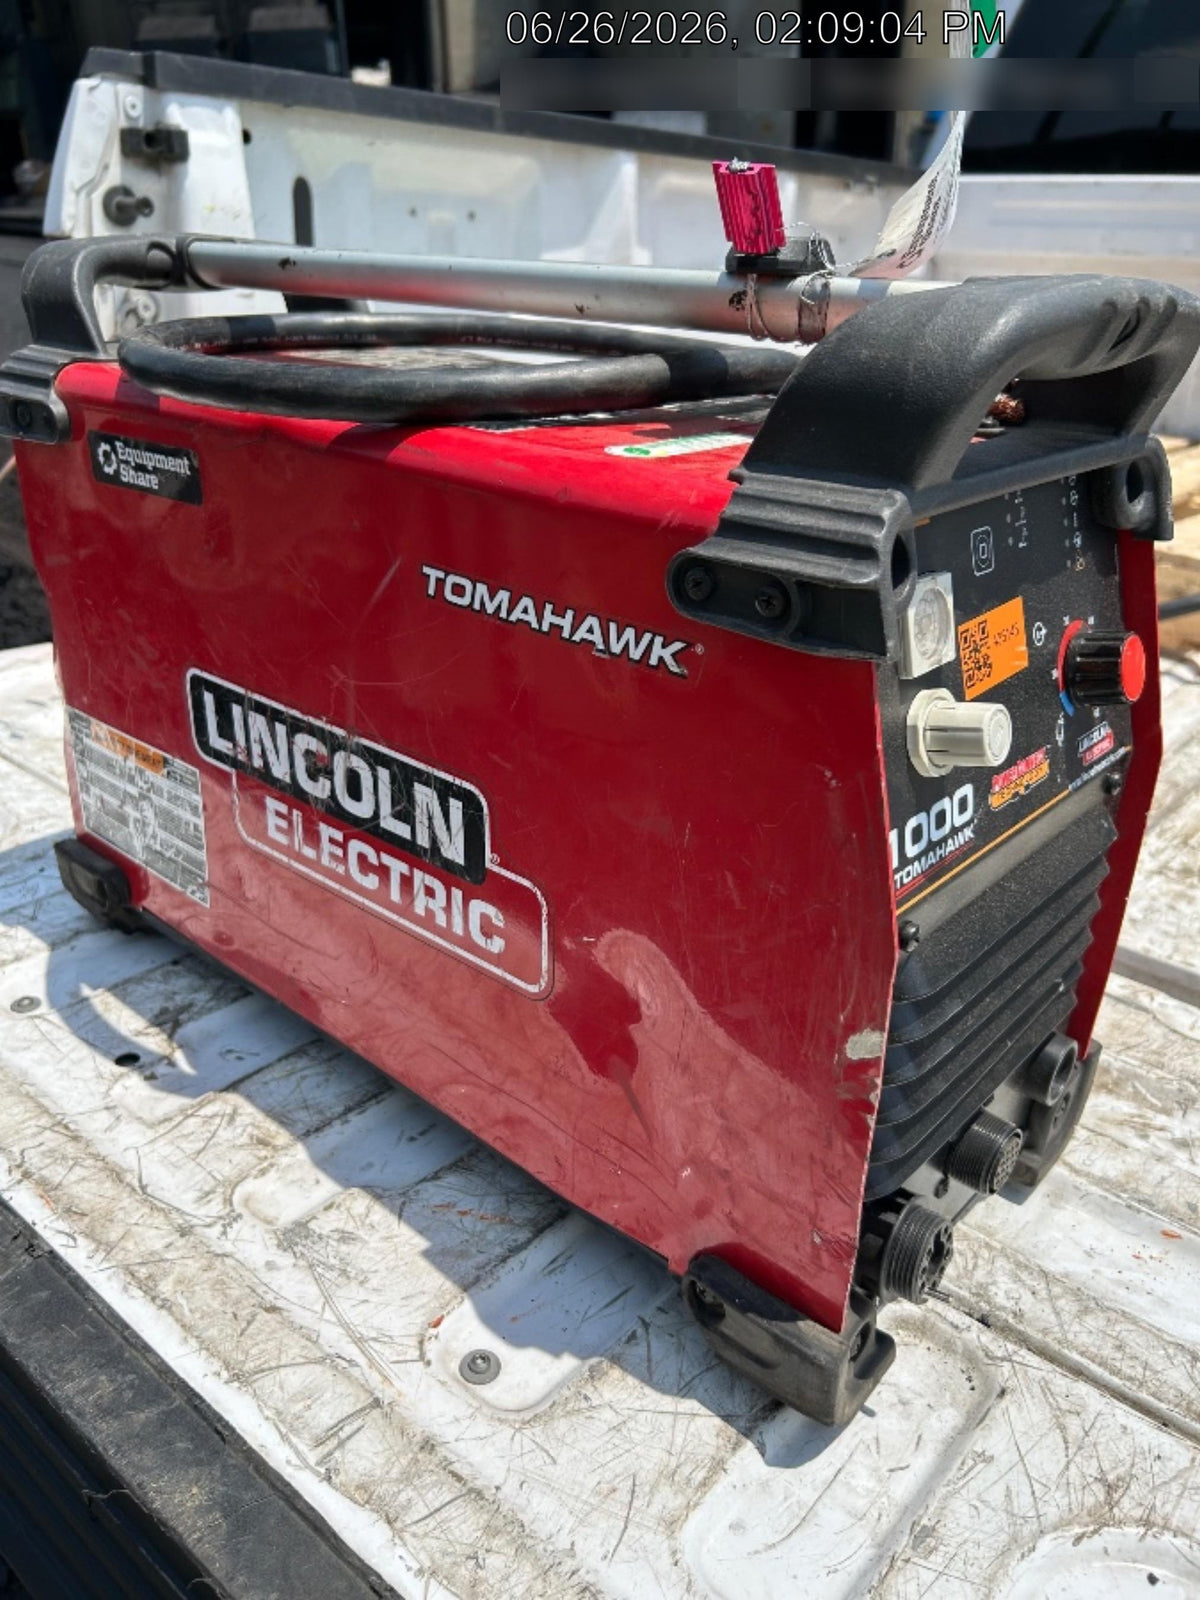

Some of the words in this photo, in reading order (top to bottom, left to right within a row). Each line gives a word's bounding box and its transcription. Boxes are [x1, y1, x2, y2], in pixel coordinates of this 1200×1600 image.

[114, 440, 192, 476] Equipment
[119, 464, 160, 490] Share
[421, 564, 688, 677] TOMAHAWK
[203, 690, 466, 867] LINCOLN
[888, 783, 975, 870] 1000
[894, 823, 976, 889] TOMAHAWK
[264, 795, 506, 955] ELECTRIC
